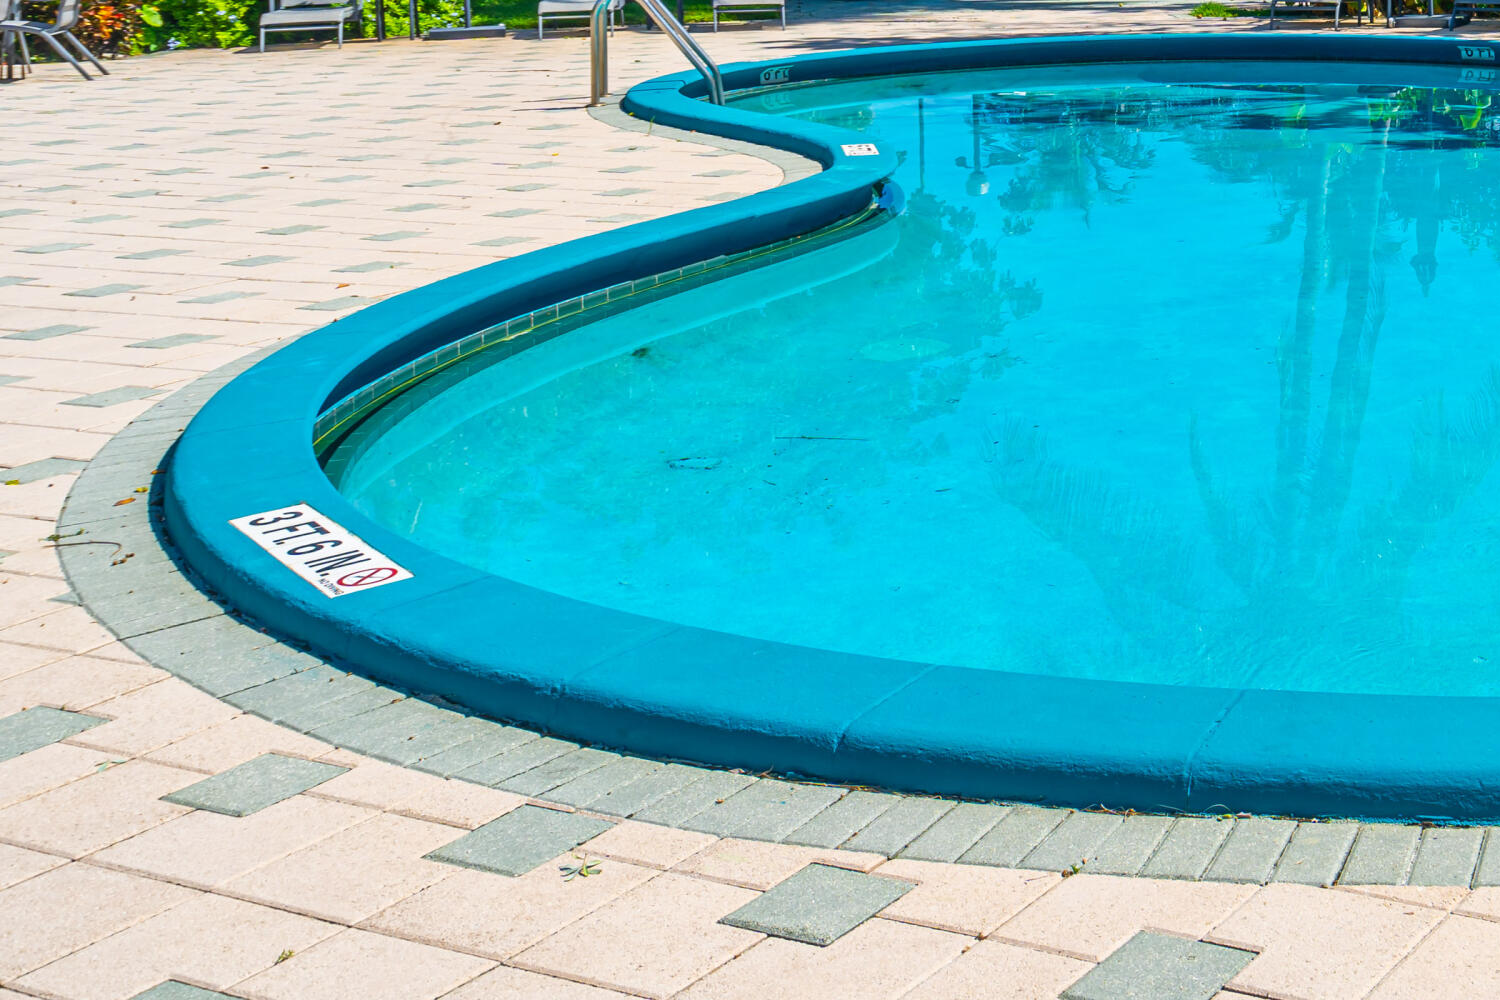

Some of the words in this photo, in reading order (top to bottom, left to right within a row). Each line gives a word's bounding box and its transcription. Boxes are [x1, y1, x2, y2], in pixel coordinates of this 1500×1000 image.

[248, 511, 303, 526] 3
[261, 521, 331, 546] FT.
[287, 539, 342, 556] 6
[303, 549, 372, 577] IN.
